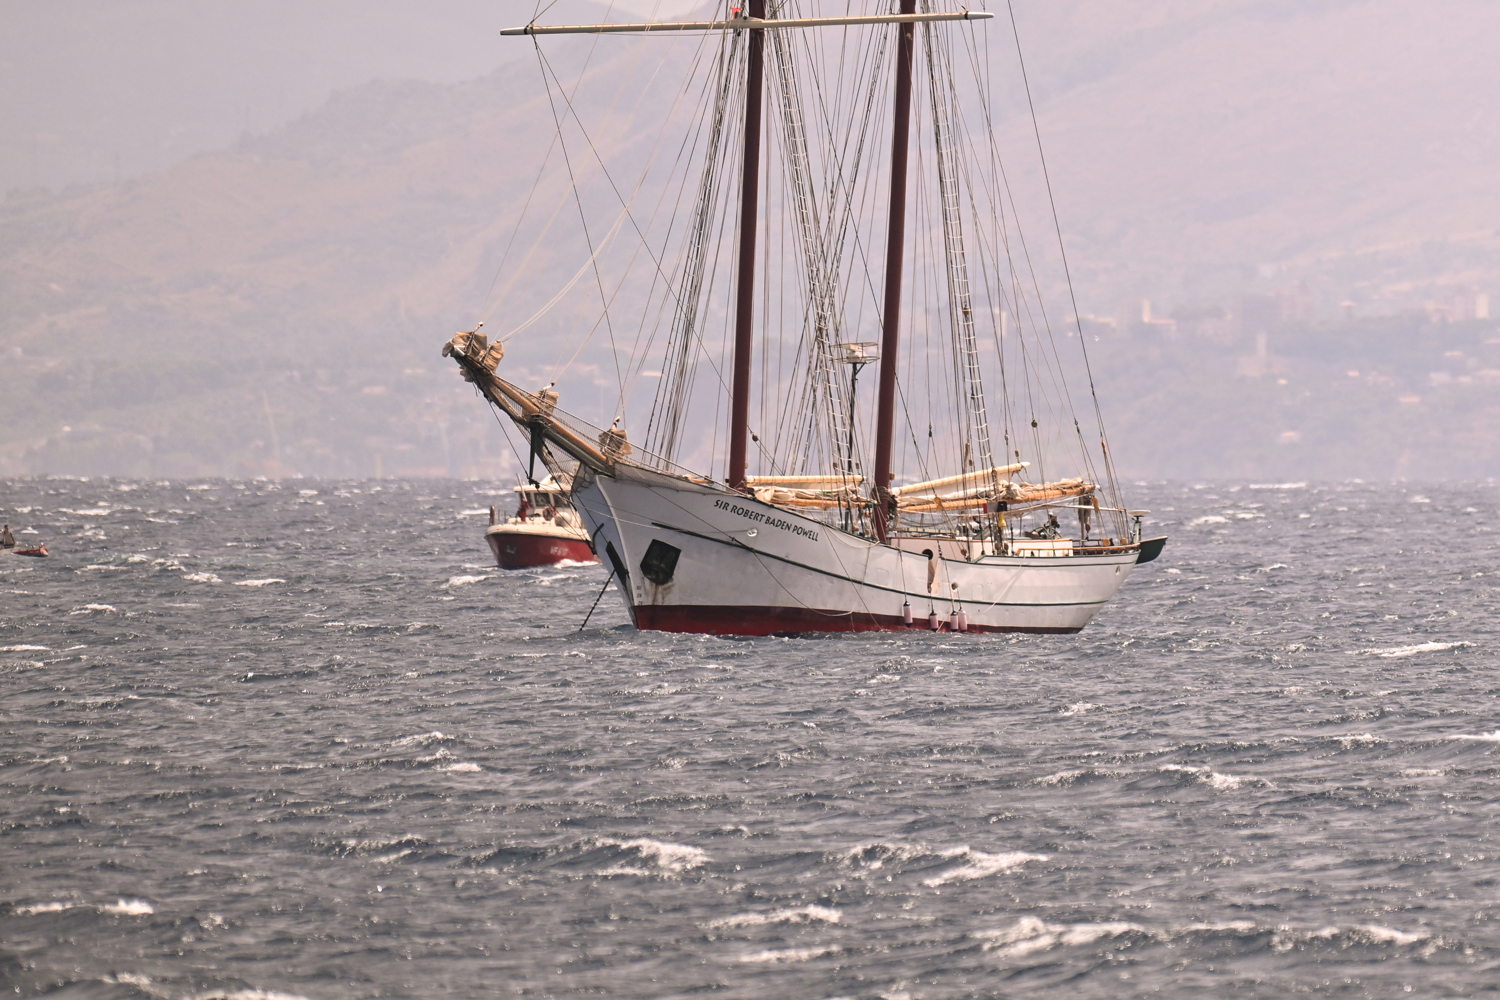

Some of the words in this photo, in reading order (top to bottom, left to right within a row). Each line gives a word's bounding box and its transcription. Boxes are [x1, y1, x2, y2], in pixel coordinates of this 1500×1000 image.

[714, 499, 729, 511] SIR
[730, 504, 765, 523] ROBERT
[765, 516, 792, 531] BADEN
[792, 525, 819, 542] POWELL
